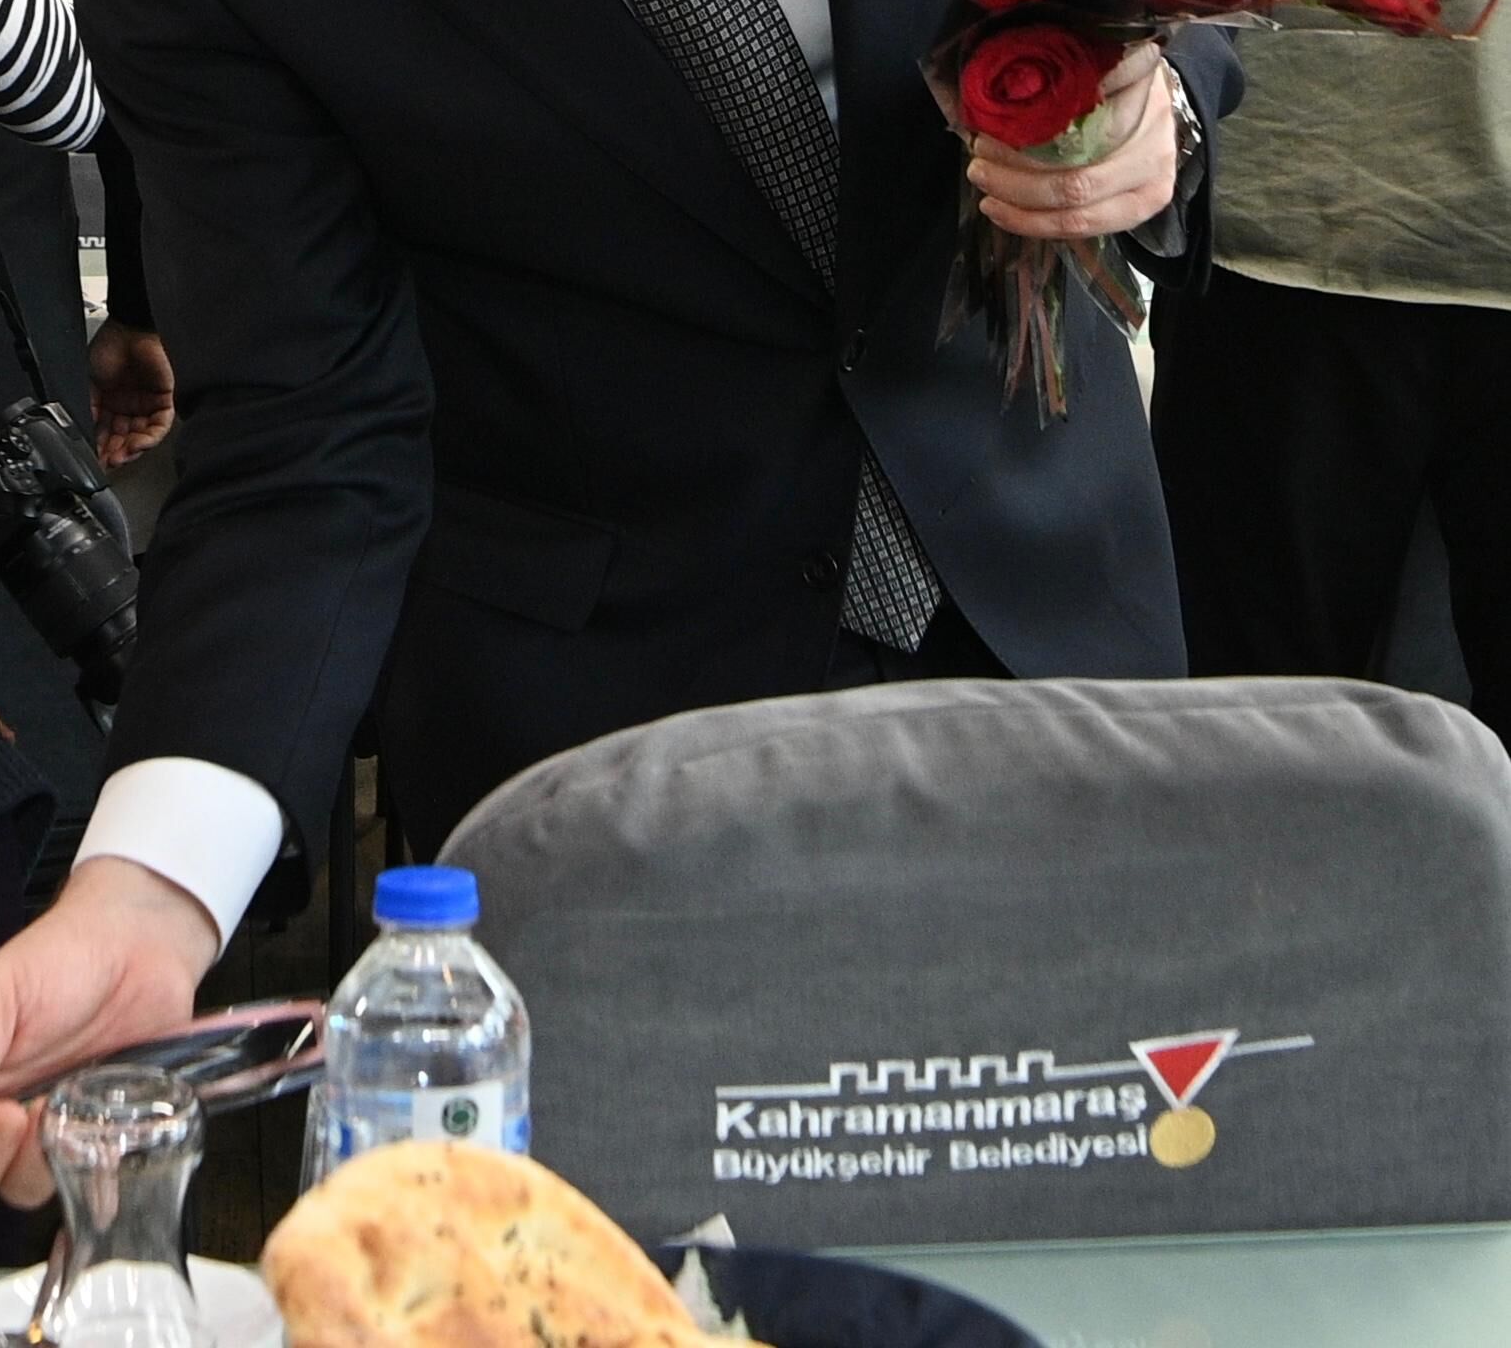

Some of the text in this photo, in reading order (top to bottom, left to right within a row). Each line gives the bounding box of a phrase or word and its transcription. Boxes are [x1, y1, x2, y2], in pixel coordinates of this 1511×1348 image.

[715, 1082, 1148, 1143] Kahramanmaraş
[713, 1122, 1148, 1186] Büyükşehir Belediyesi
